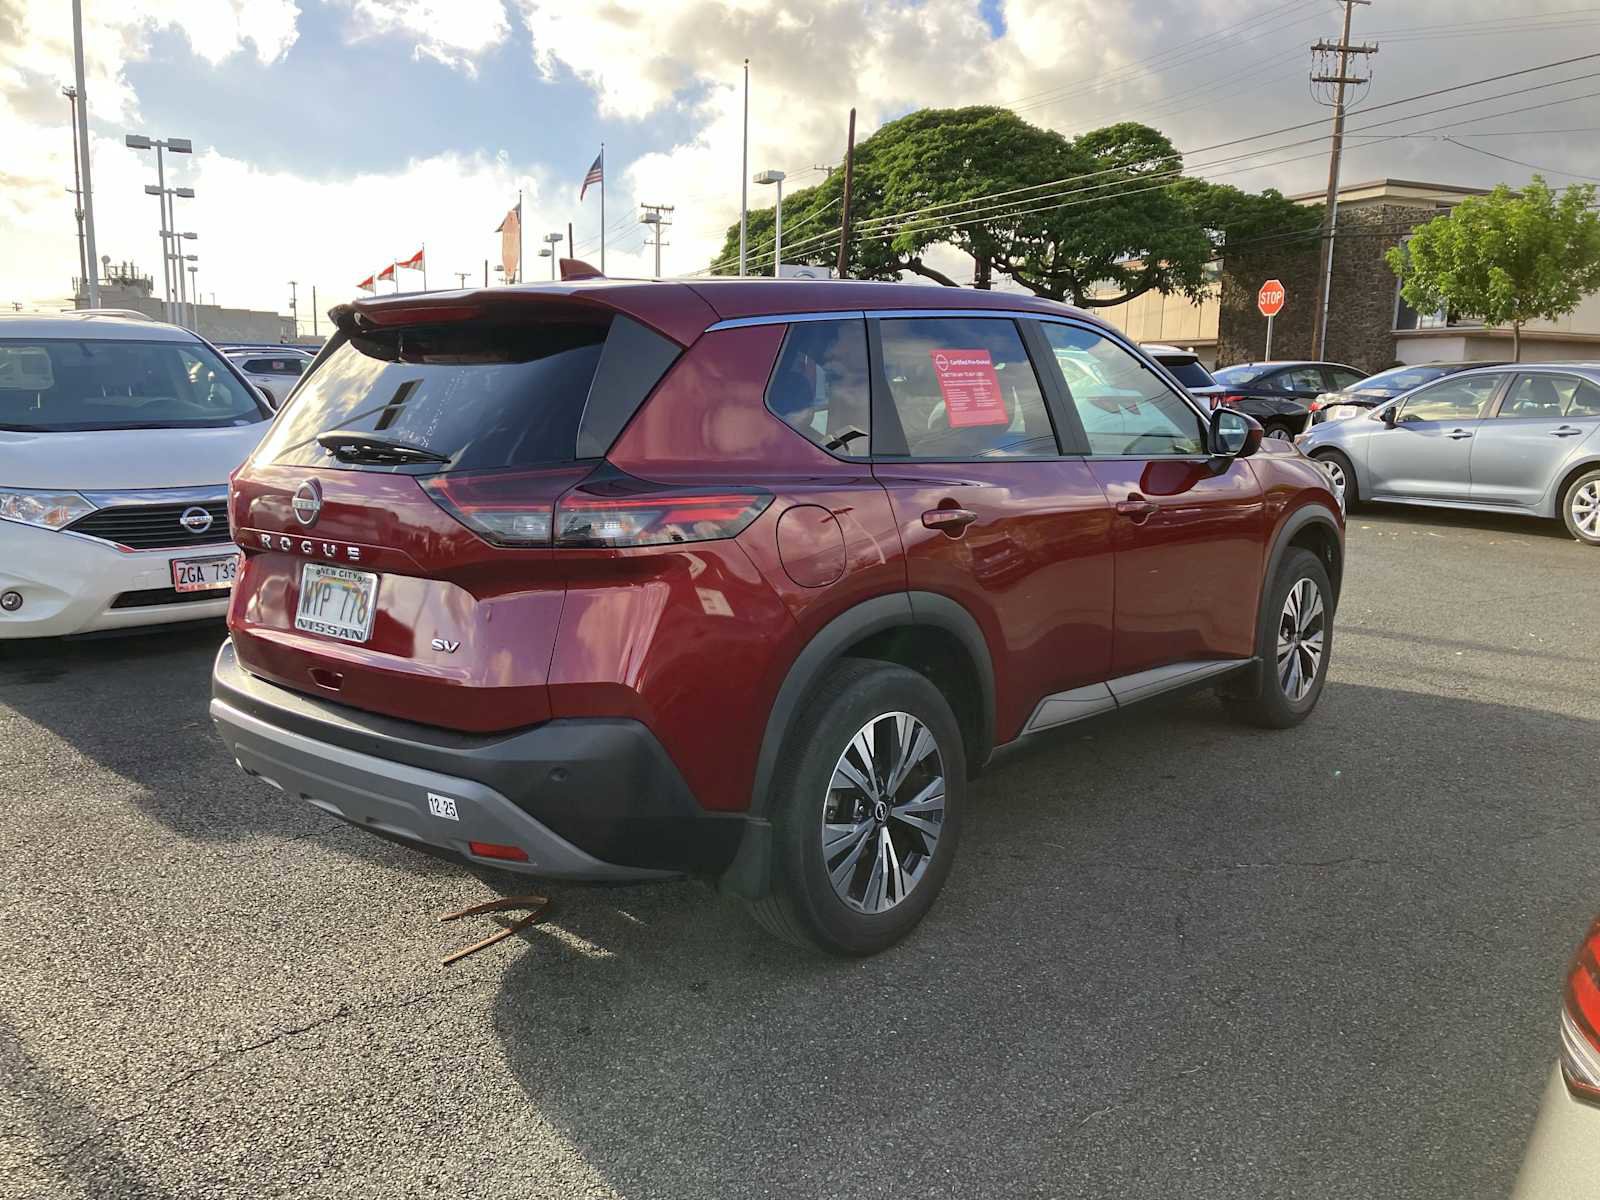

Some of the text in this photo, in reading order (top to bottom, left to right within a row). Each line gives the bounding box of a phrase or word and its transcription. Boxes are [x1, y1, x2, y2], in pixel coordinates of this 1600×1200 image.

[1260, 291, 1281, 305] STOP
[260, 534, 360, 560] ROGUE
[178, 567, 205, 584] ZGA
[320, 567, 337, 576] NEW
[338, 569, 358, 580] CITY
[302, 579, 369, 625] WYP 778
[297, 618, 363, 640] NISSAN
[431, 638, 460, 653] SV
